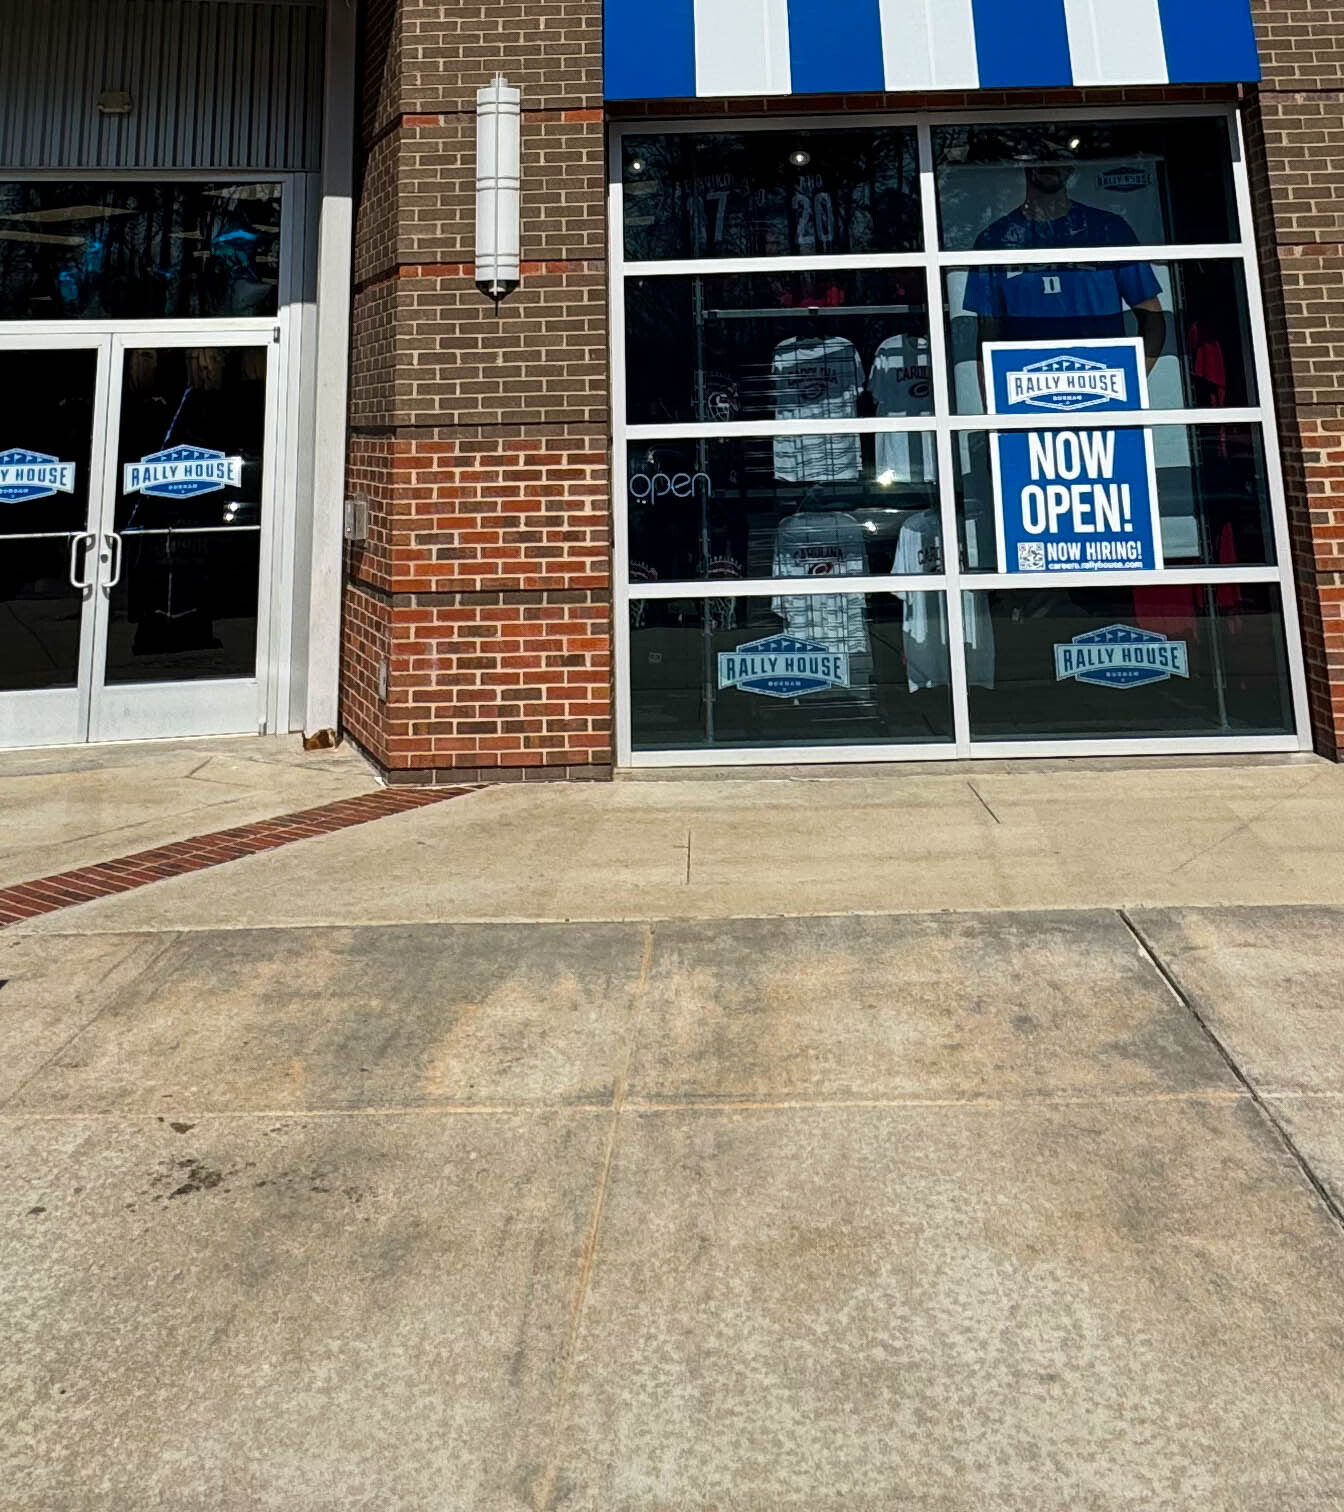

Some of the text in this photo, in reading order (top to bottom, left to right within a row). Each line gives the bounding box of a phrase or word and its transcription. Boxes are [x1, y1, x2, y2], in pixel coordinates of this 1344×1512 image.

[1015, 374, 1118, 397] RALLY HOUSE
[1028, 430, 1115, 481] NOW
[15, 467, 68, 486] HOUSE
[131, 462, 234, 487] RALLY HOUSE
[629, 472, 711, 504] open
[1021, 483, 1133, 535] OPEN!
[1046, 541, 1143, 561] NOW HIRING!
[726, 656, 842, 681] RALLY HOUSE
[1063, 647, 1180, 672] RALLY HOUSE
